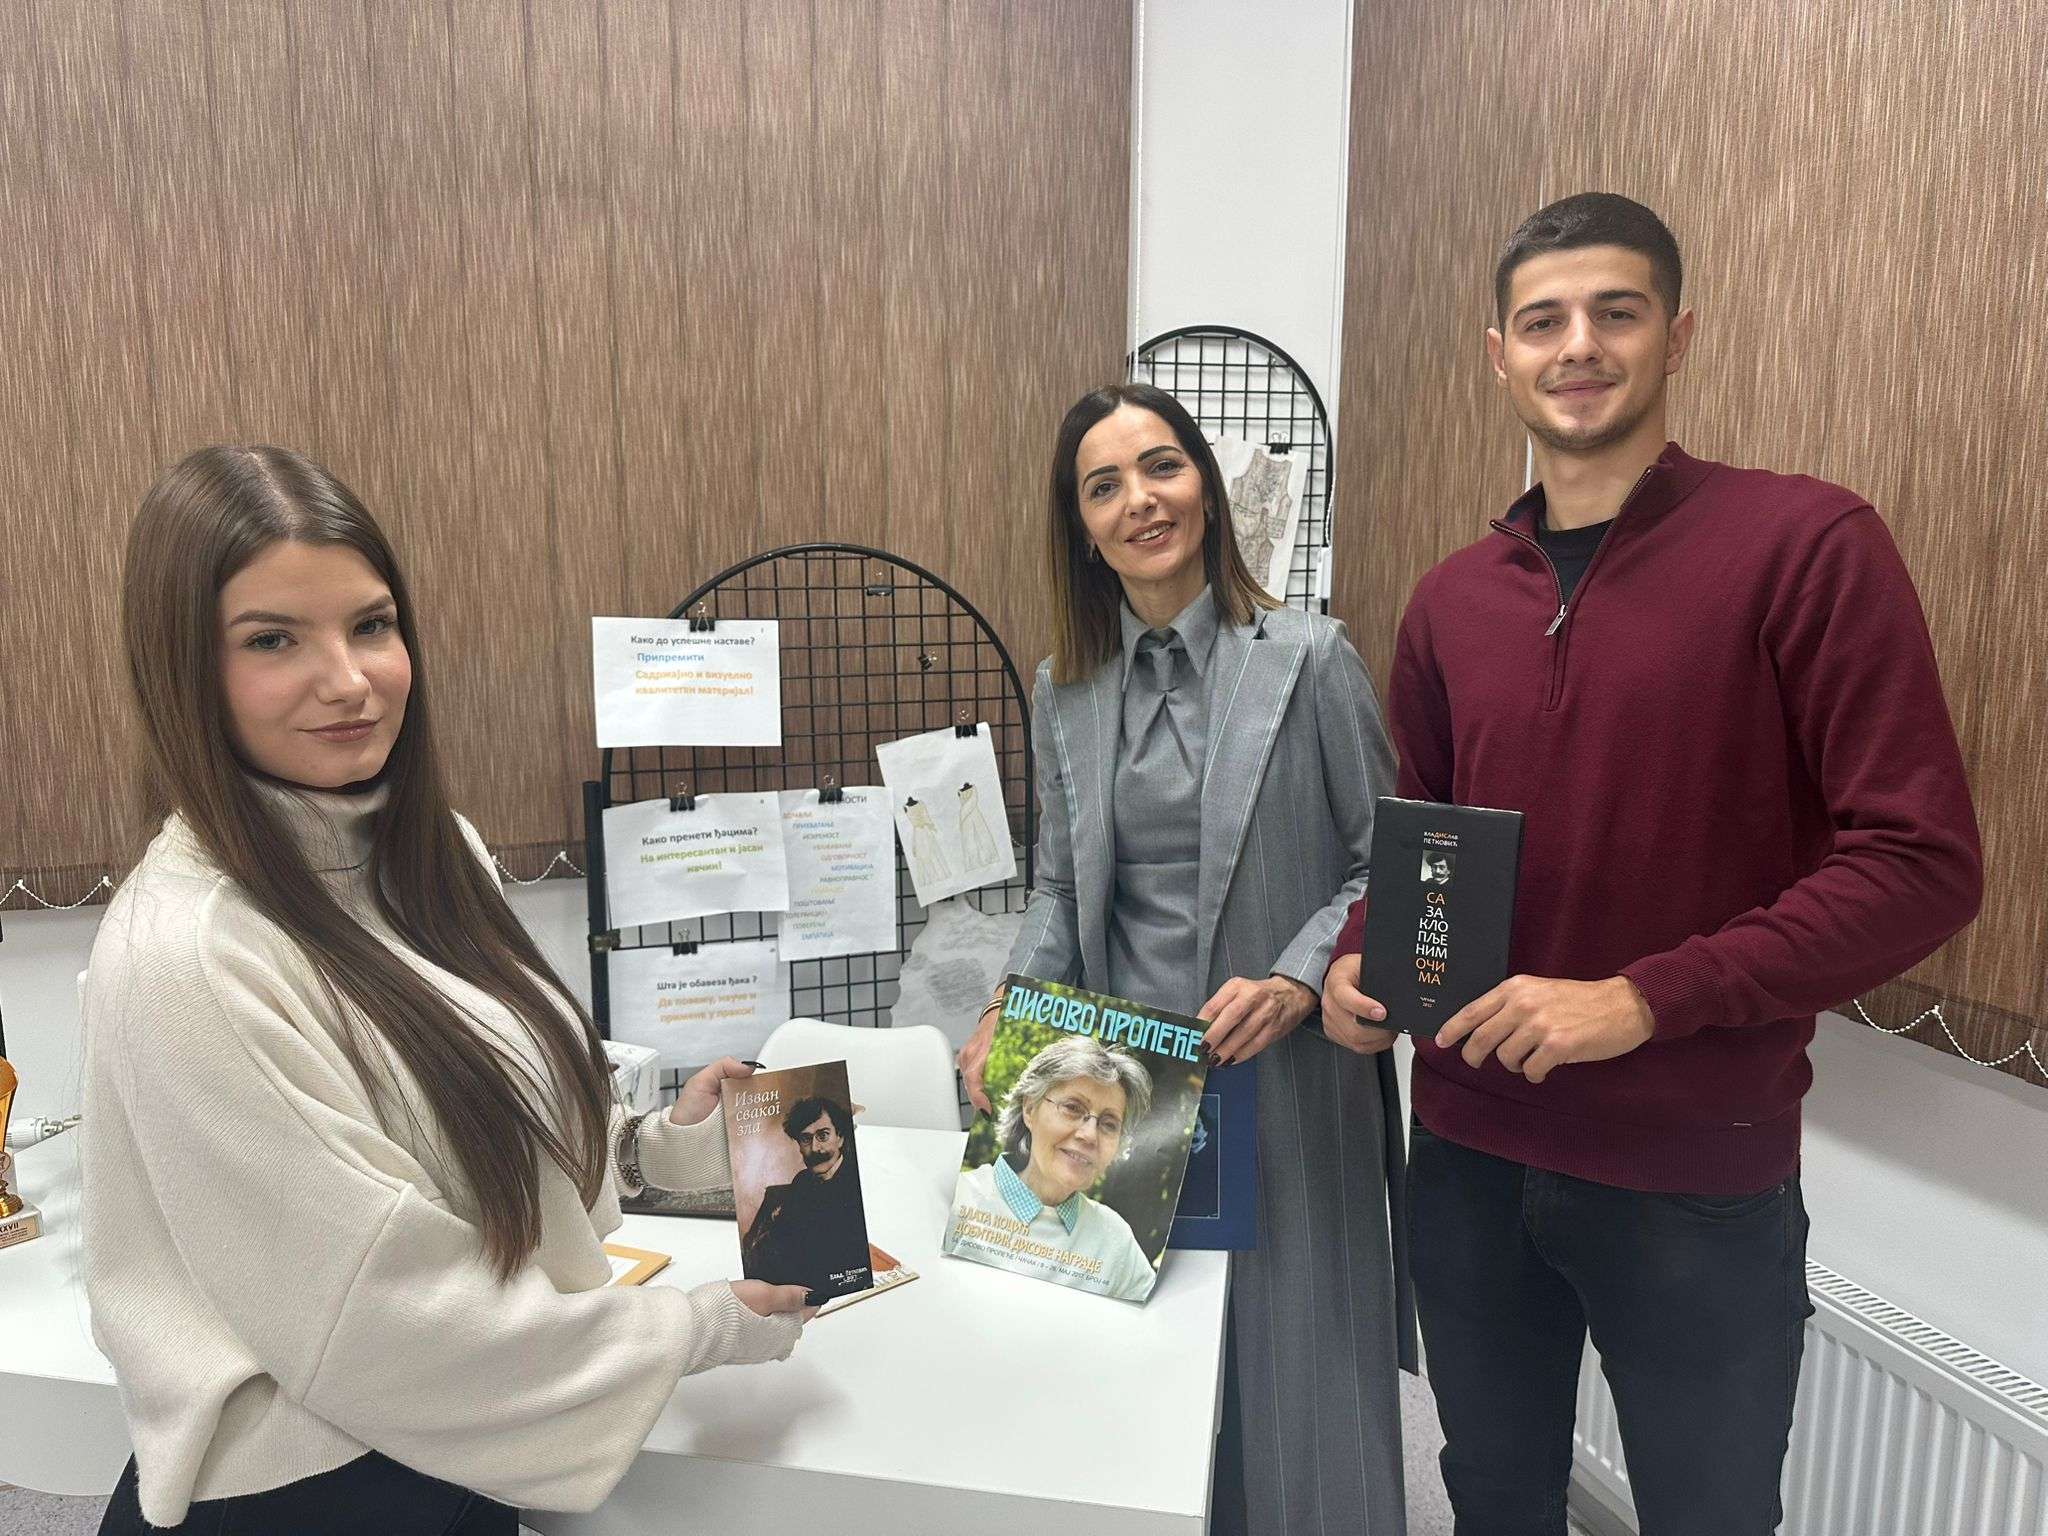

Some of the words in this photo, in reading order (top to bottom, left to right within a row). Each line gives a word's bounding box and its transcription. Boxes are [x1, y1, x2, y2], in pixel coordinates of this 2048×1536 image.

[631, 635, 654, 645] Како
[656, 637, 669, 646] до
[671, 637, 712, 647] успешне
[714, 636, 756, 646] наставе?
[637, 652, 705, 663] Припремити
[642, 836, 667, 846] Како
[670, 831, 712, 845] пренети
[714, 826, 758, 839] ђацима?
[1423, 831, 1458, 840] ВЛАДИСЛАВ
[1423, 837, 1458, 847] ПЕТКОВИЋ
[640, 853, 655, 863] На
[687, 861, 722, 873] начин!
[1426, 892, 1445, 905] СА
[1425, 905, 1444, 919] ЗА
[1419, 917, 1449, 933] КЛО
[1418, 930, 1448, 946] ПЉЕ
[1415, 943, 1448, 959] НИМ
[1415, 957, 1445, 973] ОЧИ
[656, 982, 677, 991] Шта
[679, 981, 688, 991] је
[689, 978, 727, 988] обавеза
[728, 976, 750, 986] ђака
[1418, 971, 1441, 985] МА
[1004, 985, 1097, 1036] ДИСОВО
[1099, 1008, 1203, 1063] ПРОЛЕЋЕ
[735, 1089, 779, 1107] Изван
[736, 1122, 761, 1137] зла
[955, 1221, 1011, 1249] ДОБИТНИК
[1011, 1239, 1055, 1260] ДИСОВЕ
[1055, 1249, 1103, 1275] НАГРАДЕ
